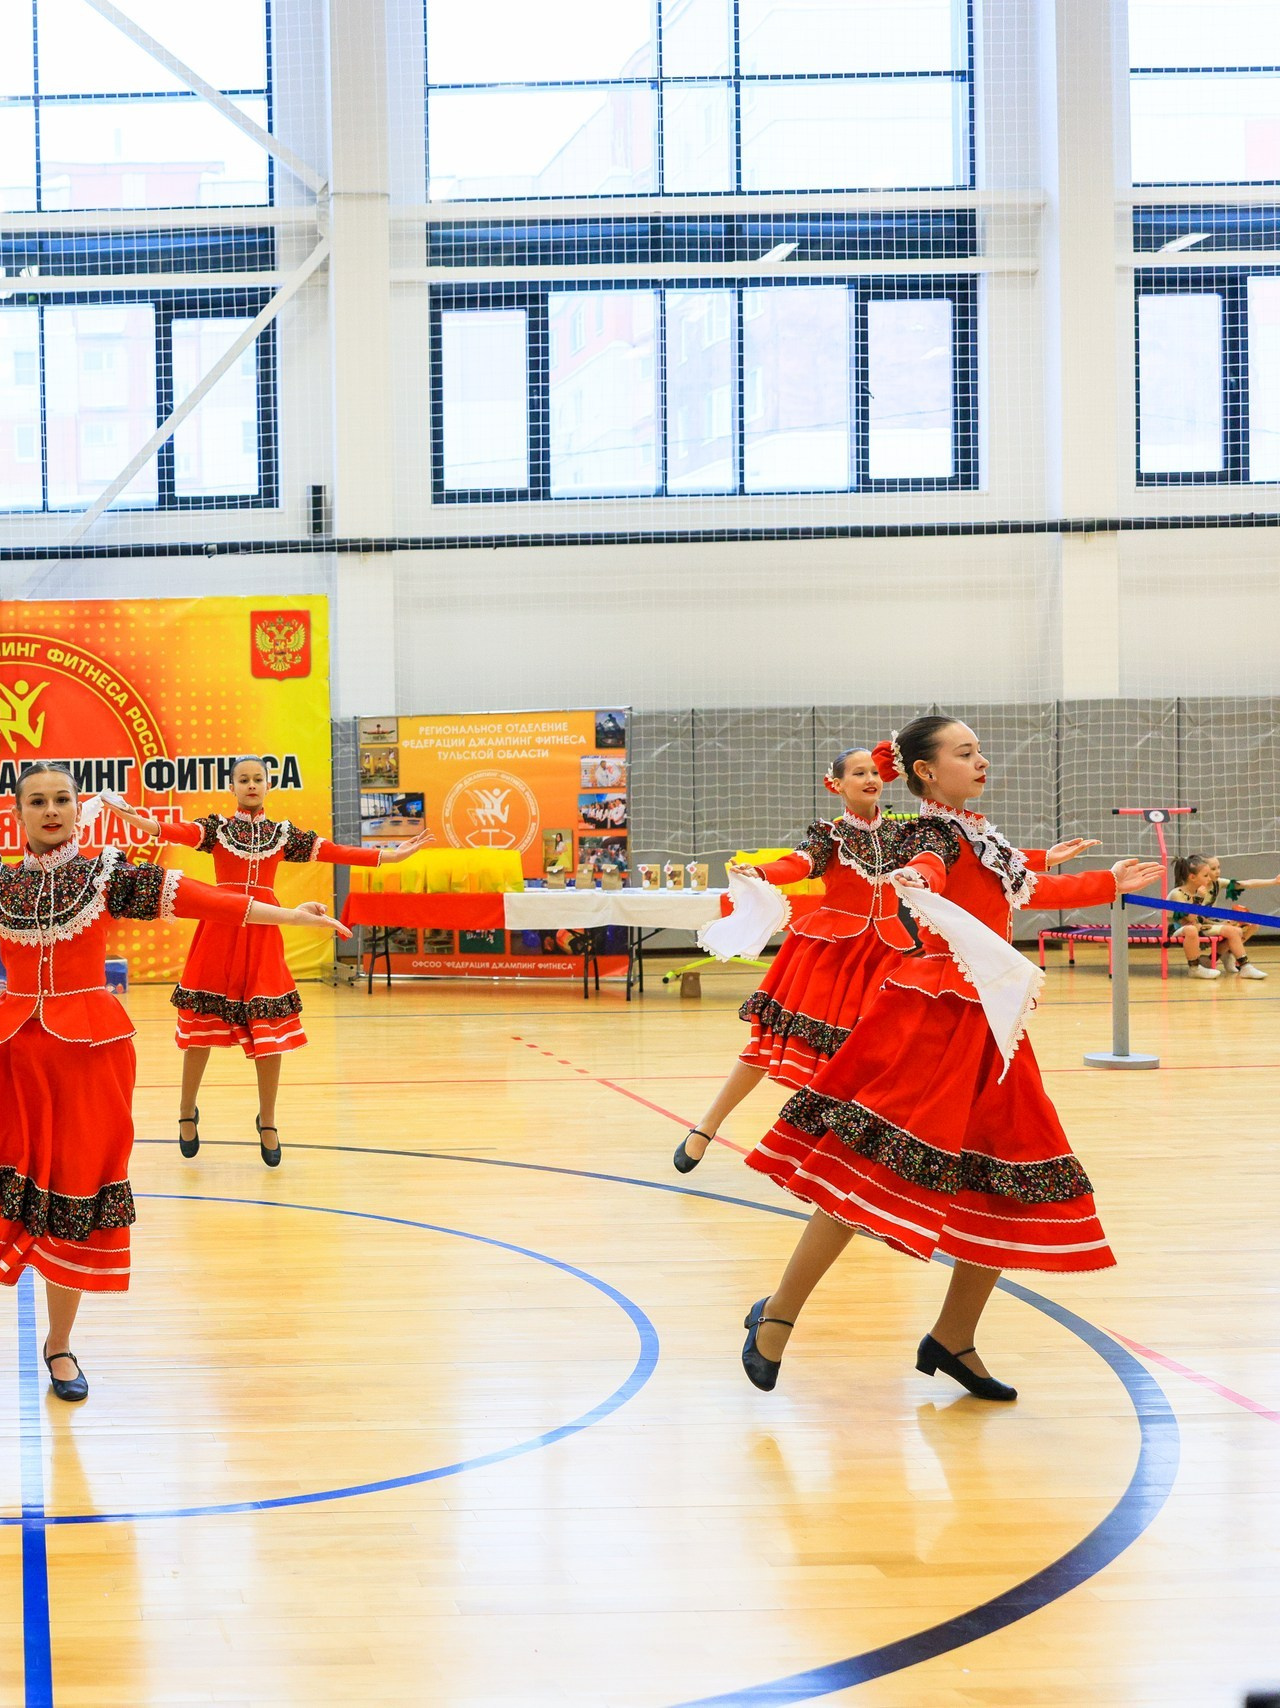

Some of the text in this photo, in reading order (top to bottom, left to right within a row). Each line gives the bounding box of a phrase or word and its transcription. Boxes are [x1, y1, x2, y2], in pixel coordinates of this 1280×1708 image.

[47, 648, 129, 709] ФИТНЕСА
[125, 706, 159, 760] РОСС
[418, 721, 569, 736] РЕГИОНАЛЬНОЕ ОТДЕЛЕНИЕ
[401, 734, 587, 750] ФЕДЕРАЦИИ ДЖАМПИНГ ФИТНЕСА
[437, 748, 549, 761] ТУЛЬСКОЙ ОБЛАСТИ
[143, 754, 303, 794] ФИТНСА
[491, 961, 536, 970] ДЖАМПИНГ
